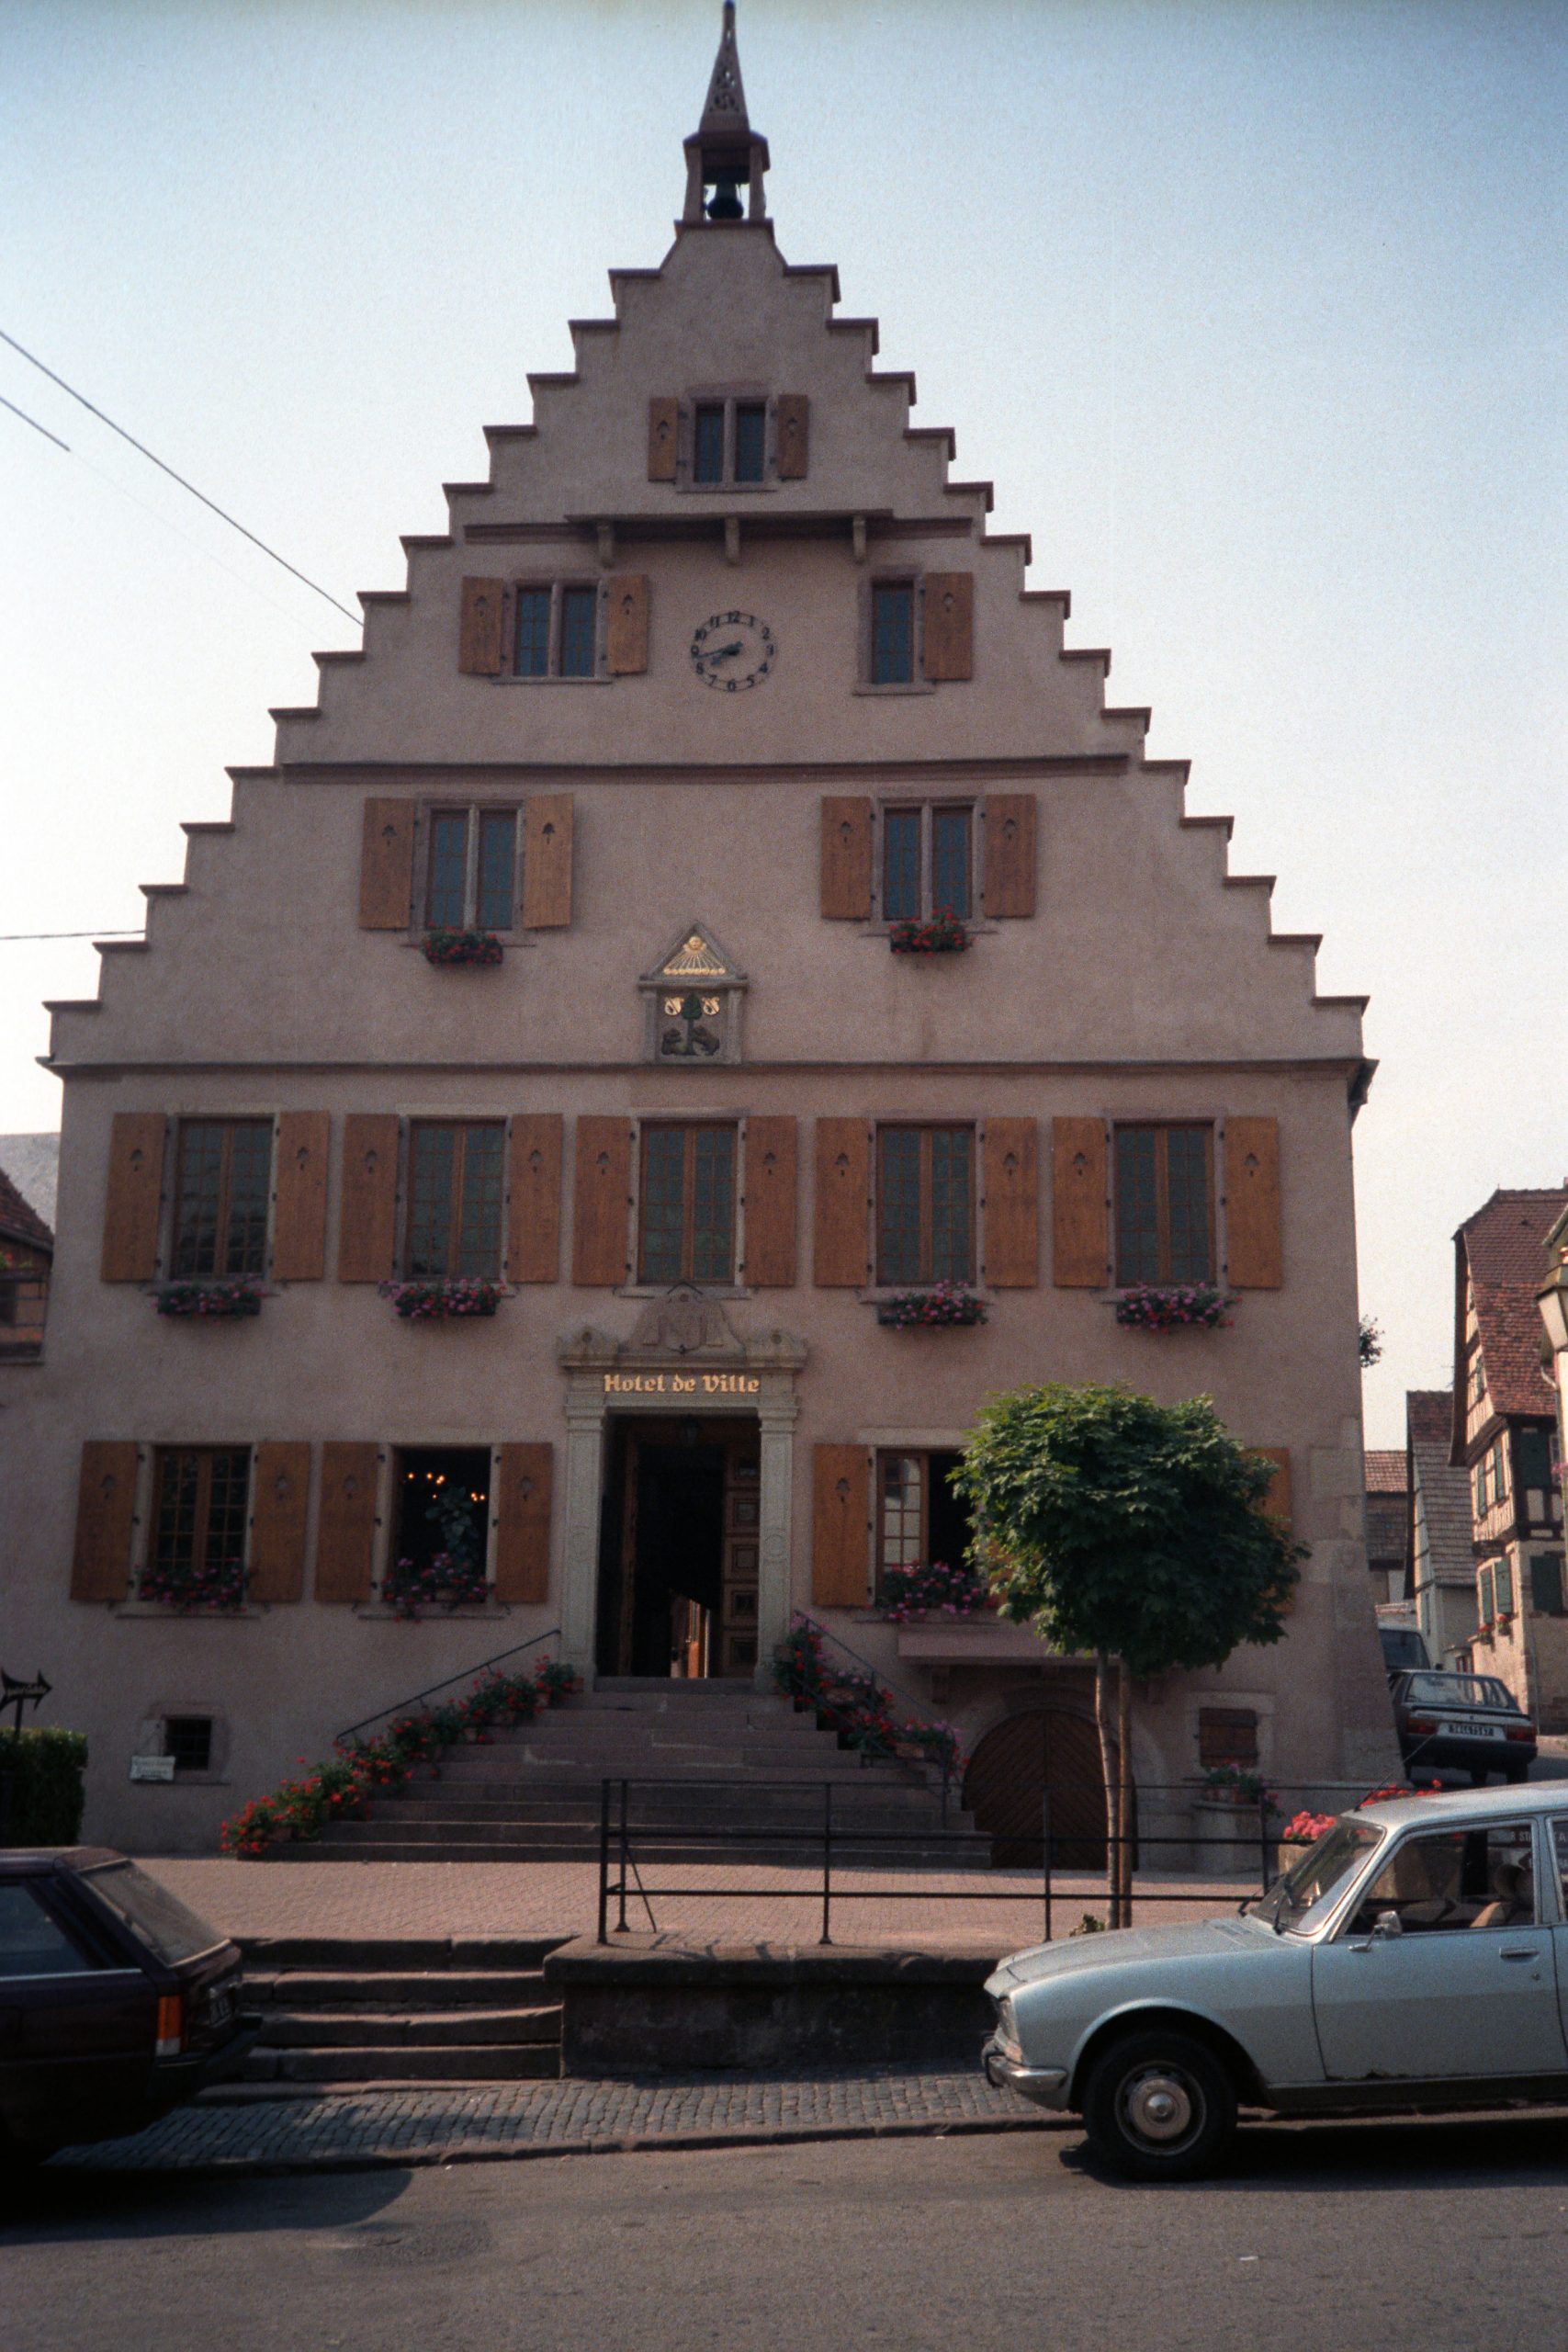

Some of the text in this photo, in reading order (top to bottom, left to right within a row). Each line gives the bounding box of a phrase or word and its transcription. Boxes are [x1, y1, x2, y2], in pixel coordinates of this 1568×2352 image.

[728, 611, 740, 624] 12
[750, 616, 755, 628] 1
[762, 627, 771, 640] 2
[767, 644, 774, 656] 3
[696, 662, 704, 675] 8
[759, 662, 768, 673] 4
[709, 674, 717, 686] 7
[728, 679, 736, 692] 6
[747, 674, 755, 688] 5
[604, 1373, 761, 1394] Hotel de Ville
